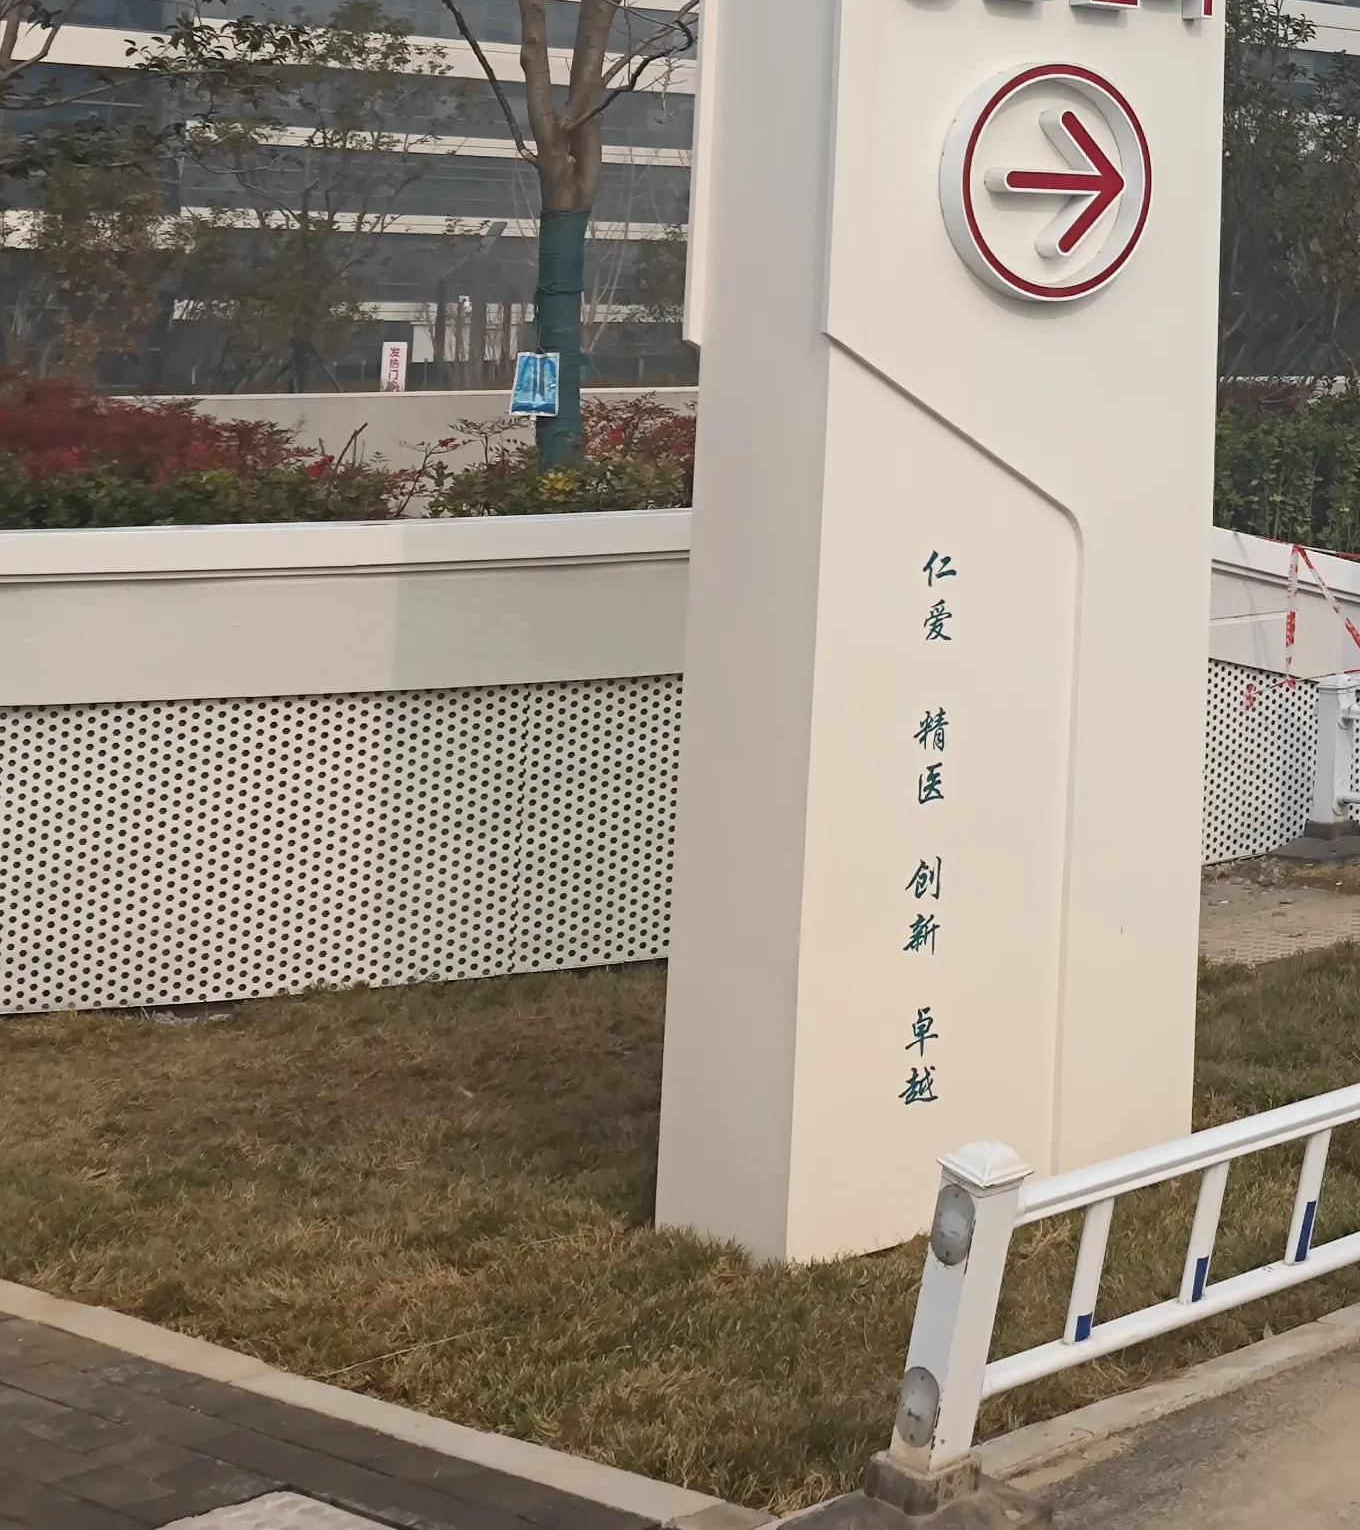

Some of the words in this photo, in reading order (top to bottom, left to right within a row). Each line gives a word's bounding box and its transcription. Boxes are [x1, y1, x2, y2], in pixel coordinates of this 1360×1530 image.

[922, 550, 957, 641] 仁爱
[913, 707, 949, 804] 精医
[903, 855, 941, 956] 创新
[898, 1007, 940, 1106] 卓越
